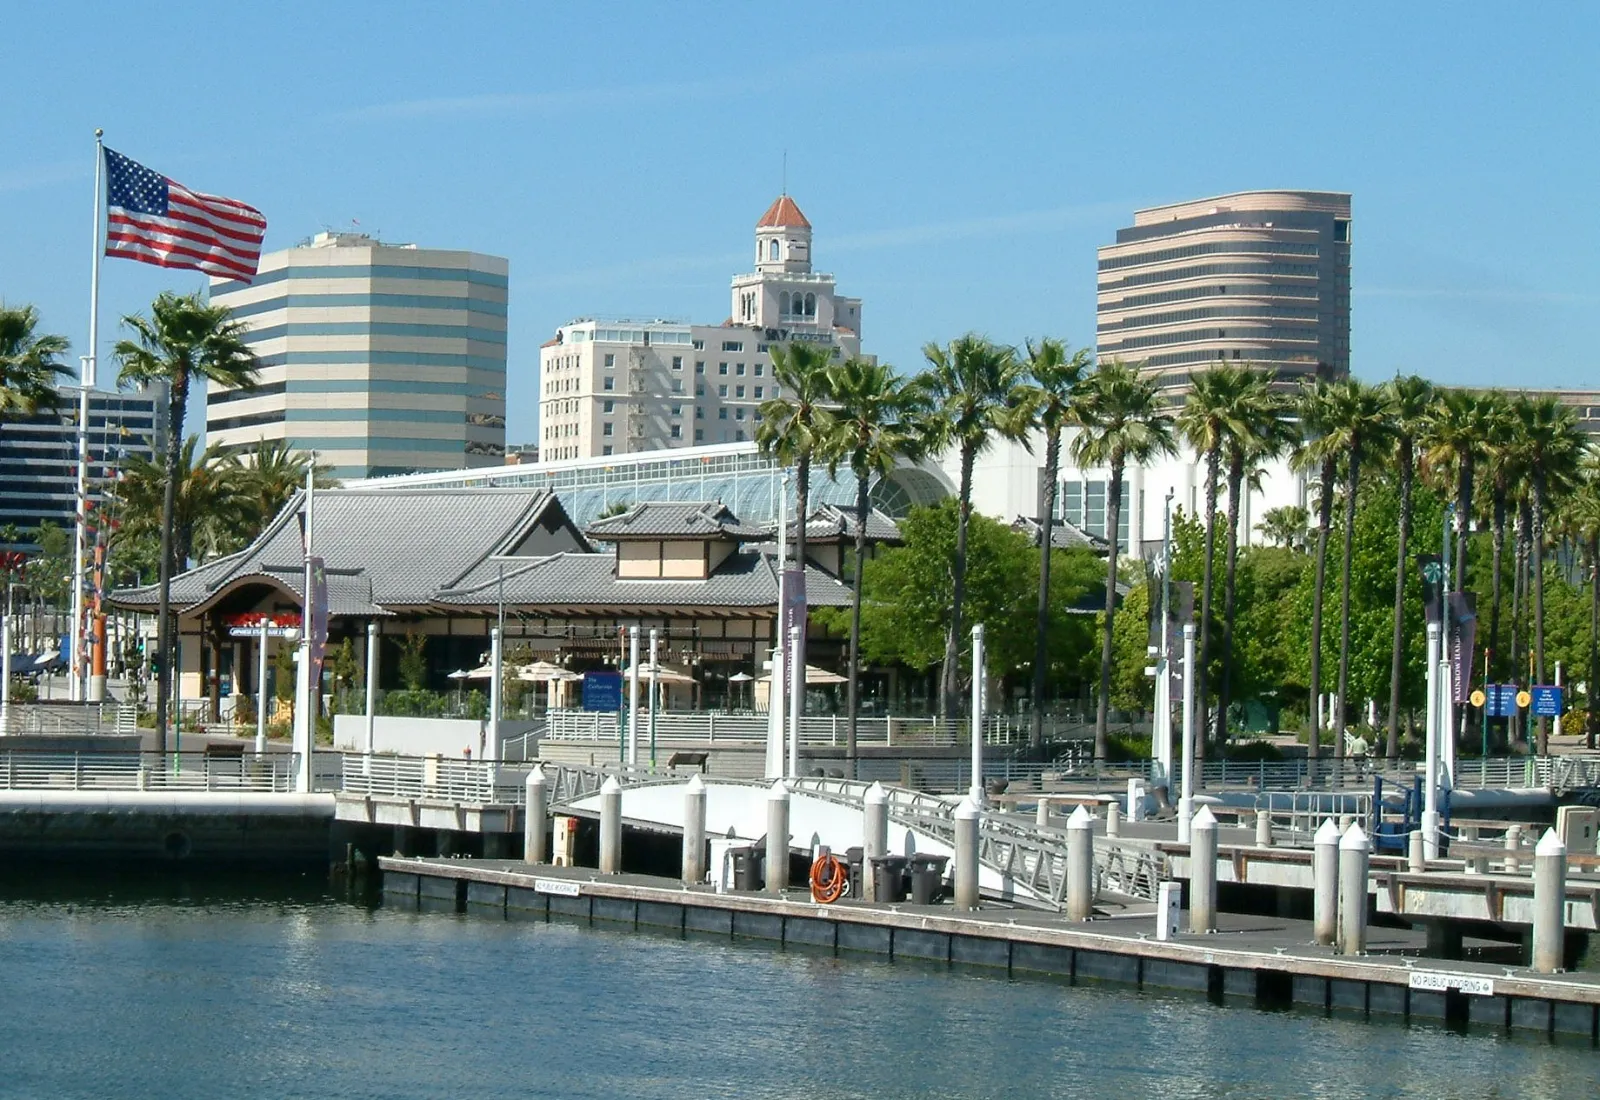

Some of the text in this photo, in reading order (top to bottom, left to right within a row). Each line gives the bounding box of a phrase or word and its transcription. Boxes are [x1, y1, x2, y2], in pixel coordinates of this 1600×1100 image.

[1411, 975, 1480, 991] NO PUBLIC MOORING
